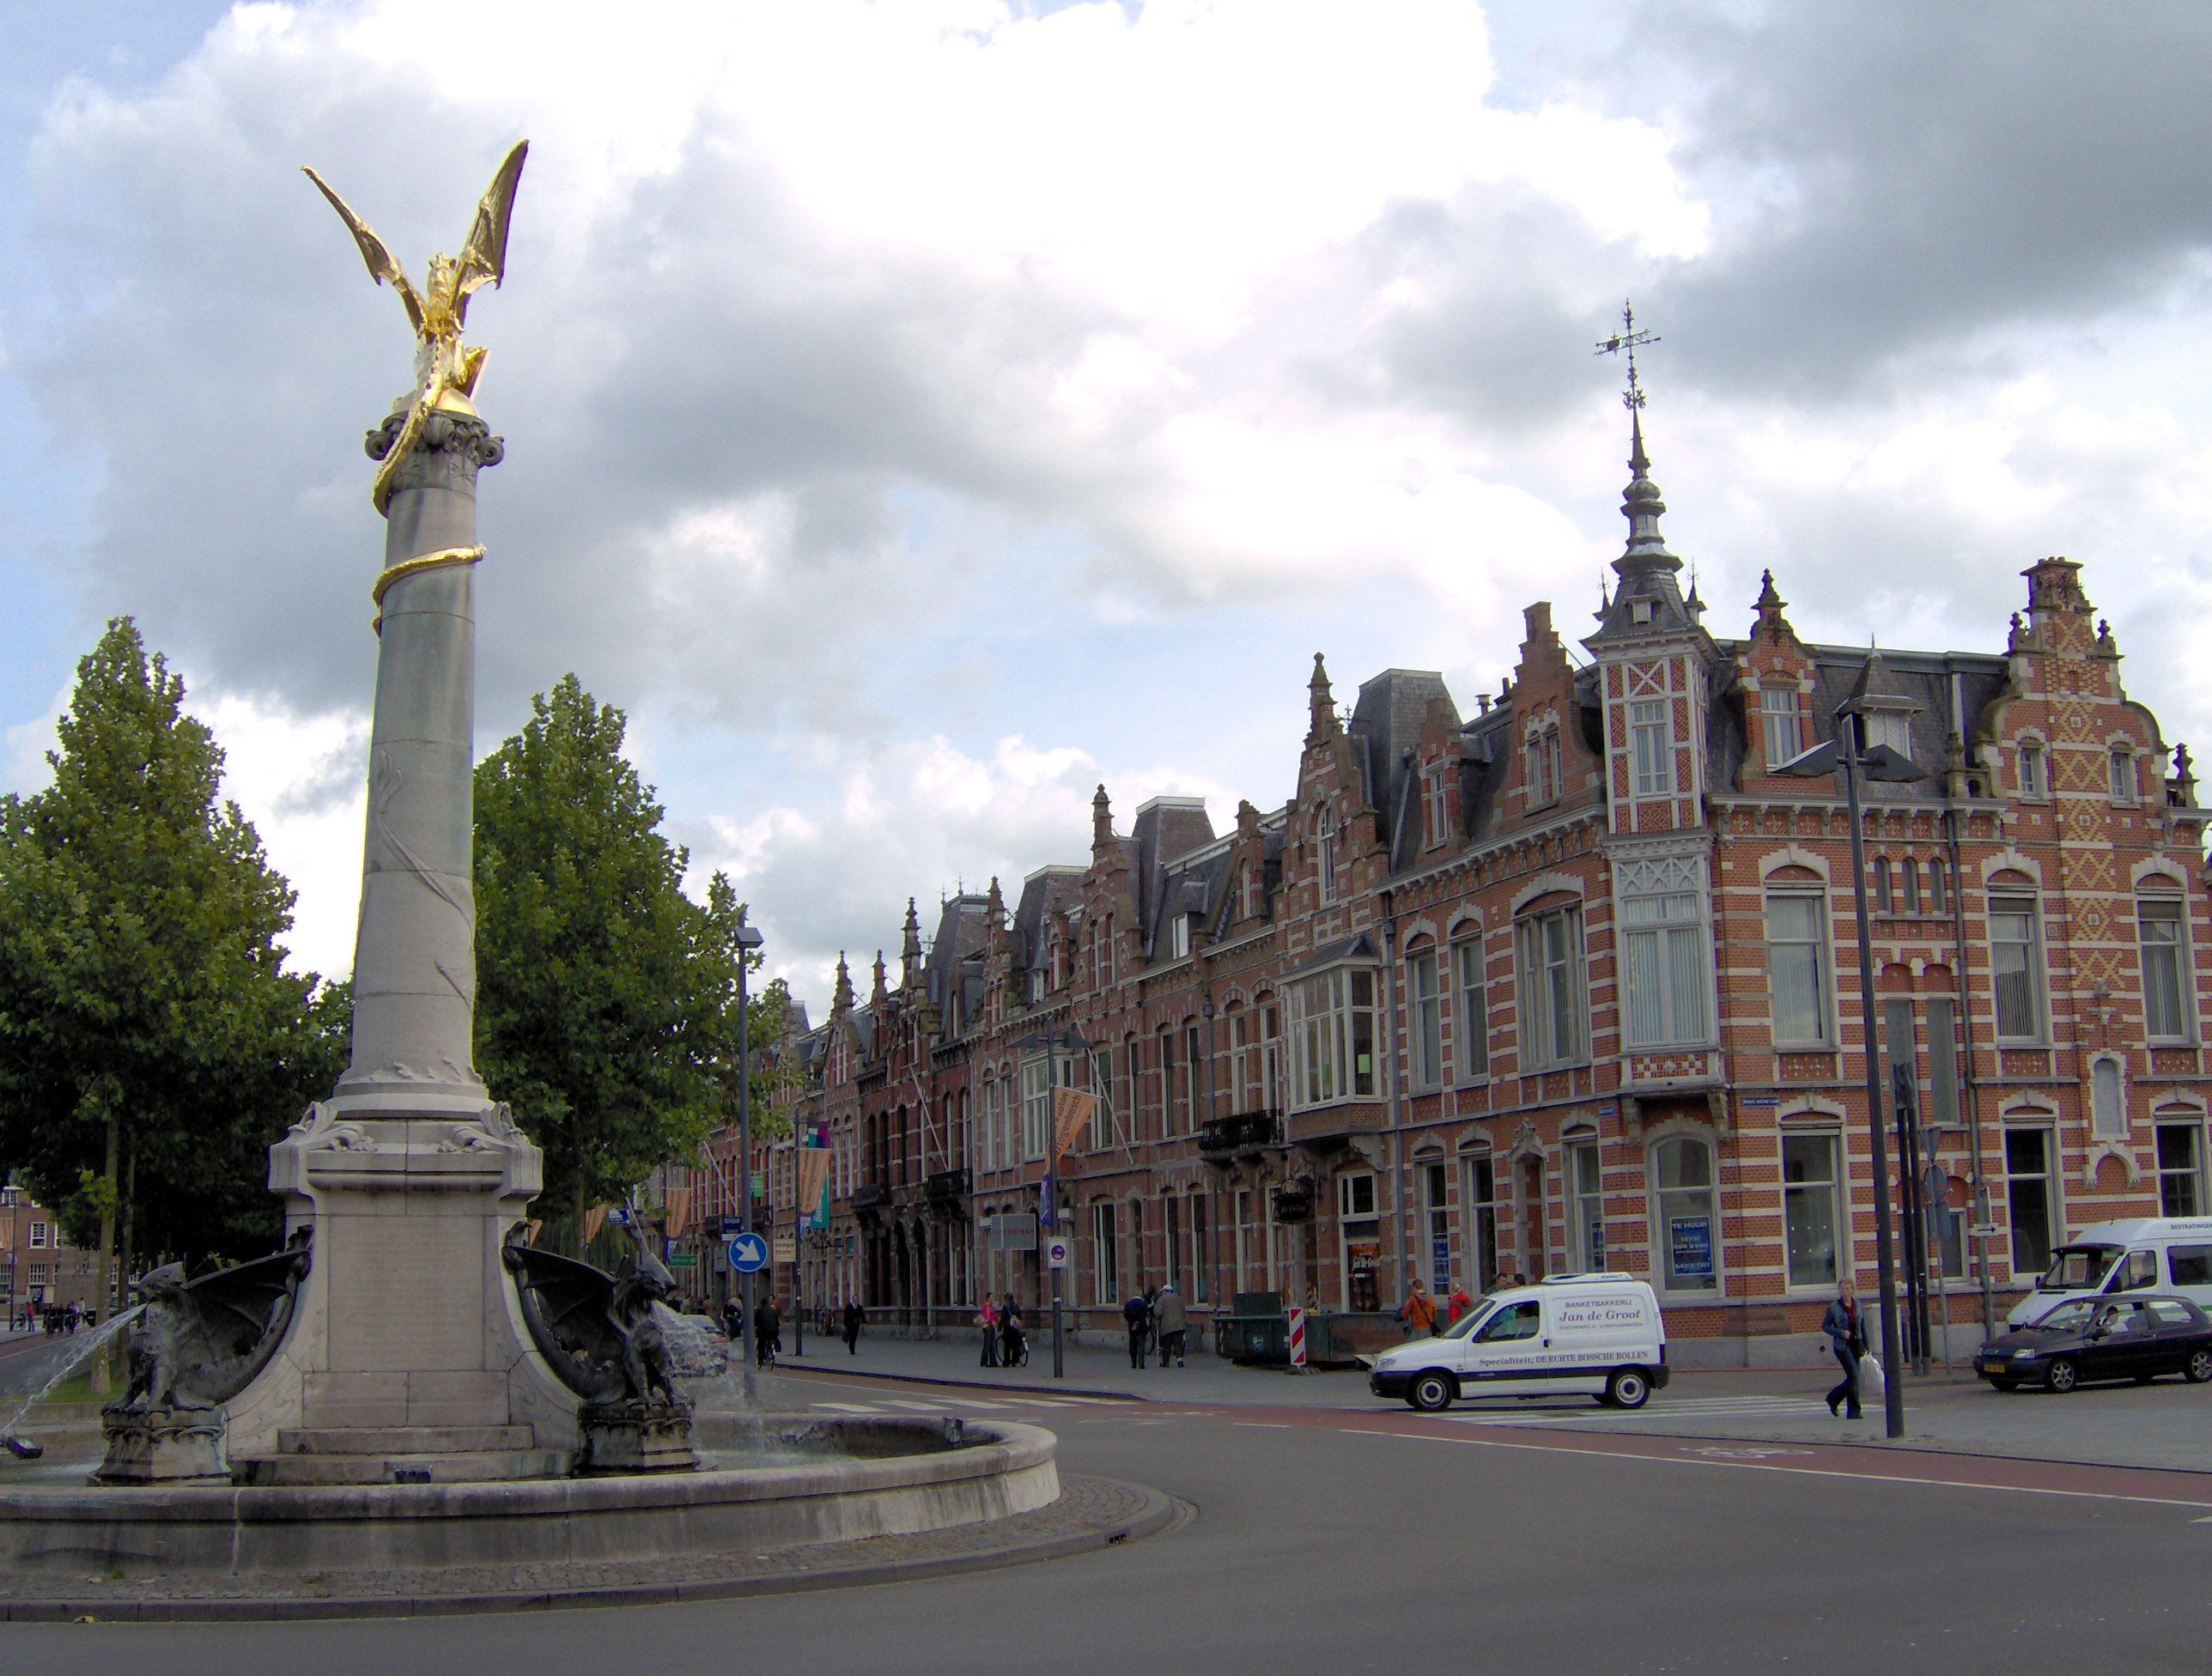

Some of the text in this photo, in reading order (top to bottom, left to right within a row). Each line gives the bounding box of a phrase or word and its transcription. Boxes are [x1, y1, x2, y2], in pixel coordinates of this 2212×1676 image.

[1565, 1299, 1632, 1308] BANKETBAKKERIJ
[1559, 1309, 1640, 1322] Jan de Groot
[1535, 1355, 1547, 1363] DE
[1548, 1353, 1576, 1363] ECHTE
[1577, 1352, 1614, 1362] BOSSCHE
[1616, 1351, 1649, 1360] BOLLEN
